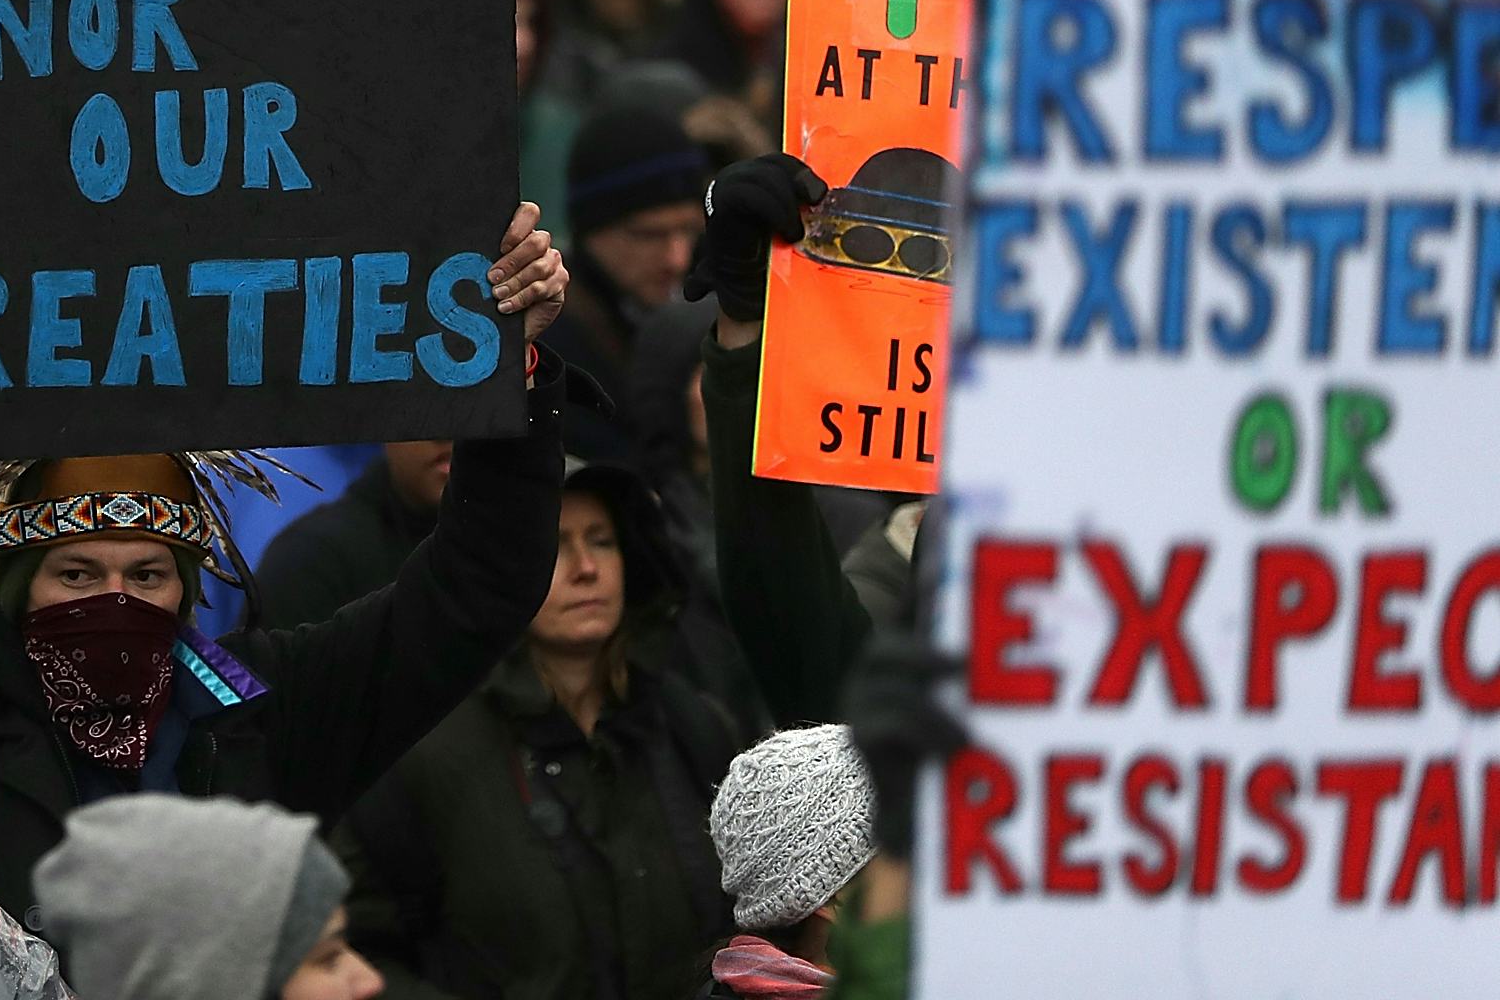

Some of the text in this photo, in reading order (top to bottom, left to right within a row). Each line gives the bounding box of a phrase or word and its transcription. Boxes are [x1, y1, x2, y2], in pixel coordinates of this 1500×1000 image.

[815, 45, 881, 101] AT
[69, 81, 312, 203] OUR
[887, 338, 933, 393] IS
[819, 402, 935, 464] STIL
[1228, 388, 1394, 518] OR
[966, 533, 1500, 717] EXPEC
[943, 746, 1500, 912] RESISTA
